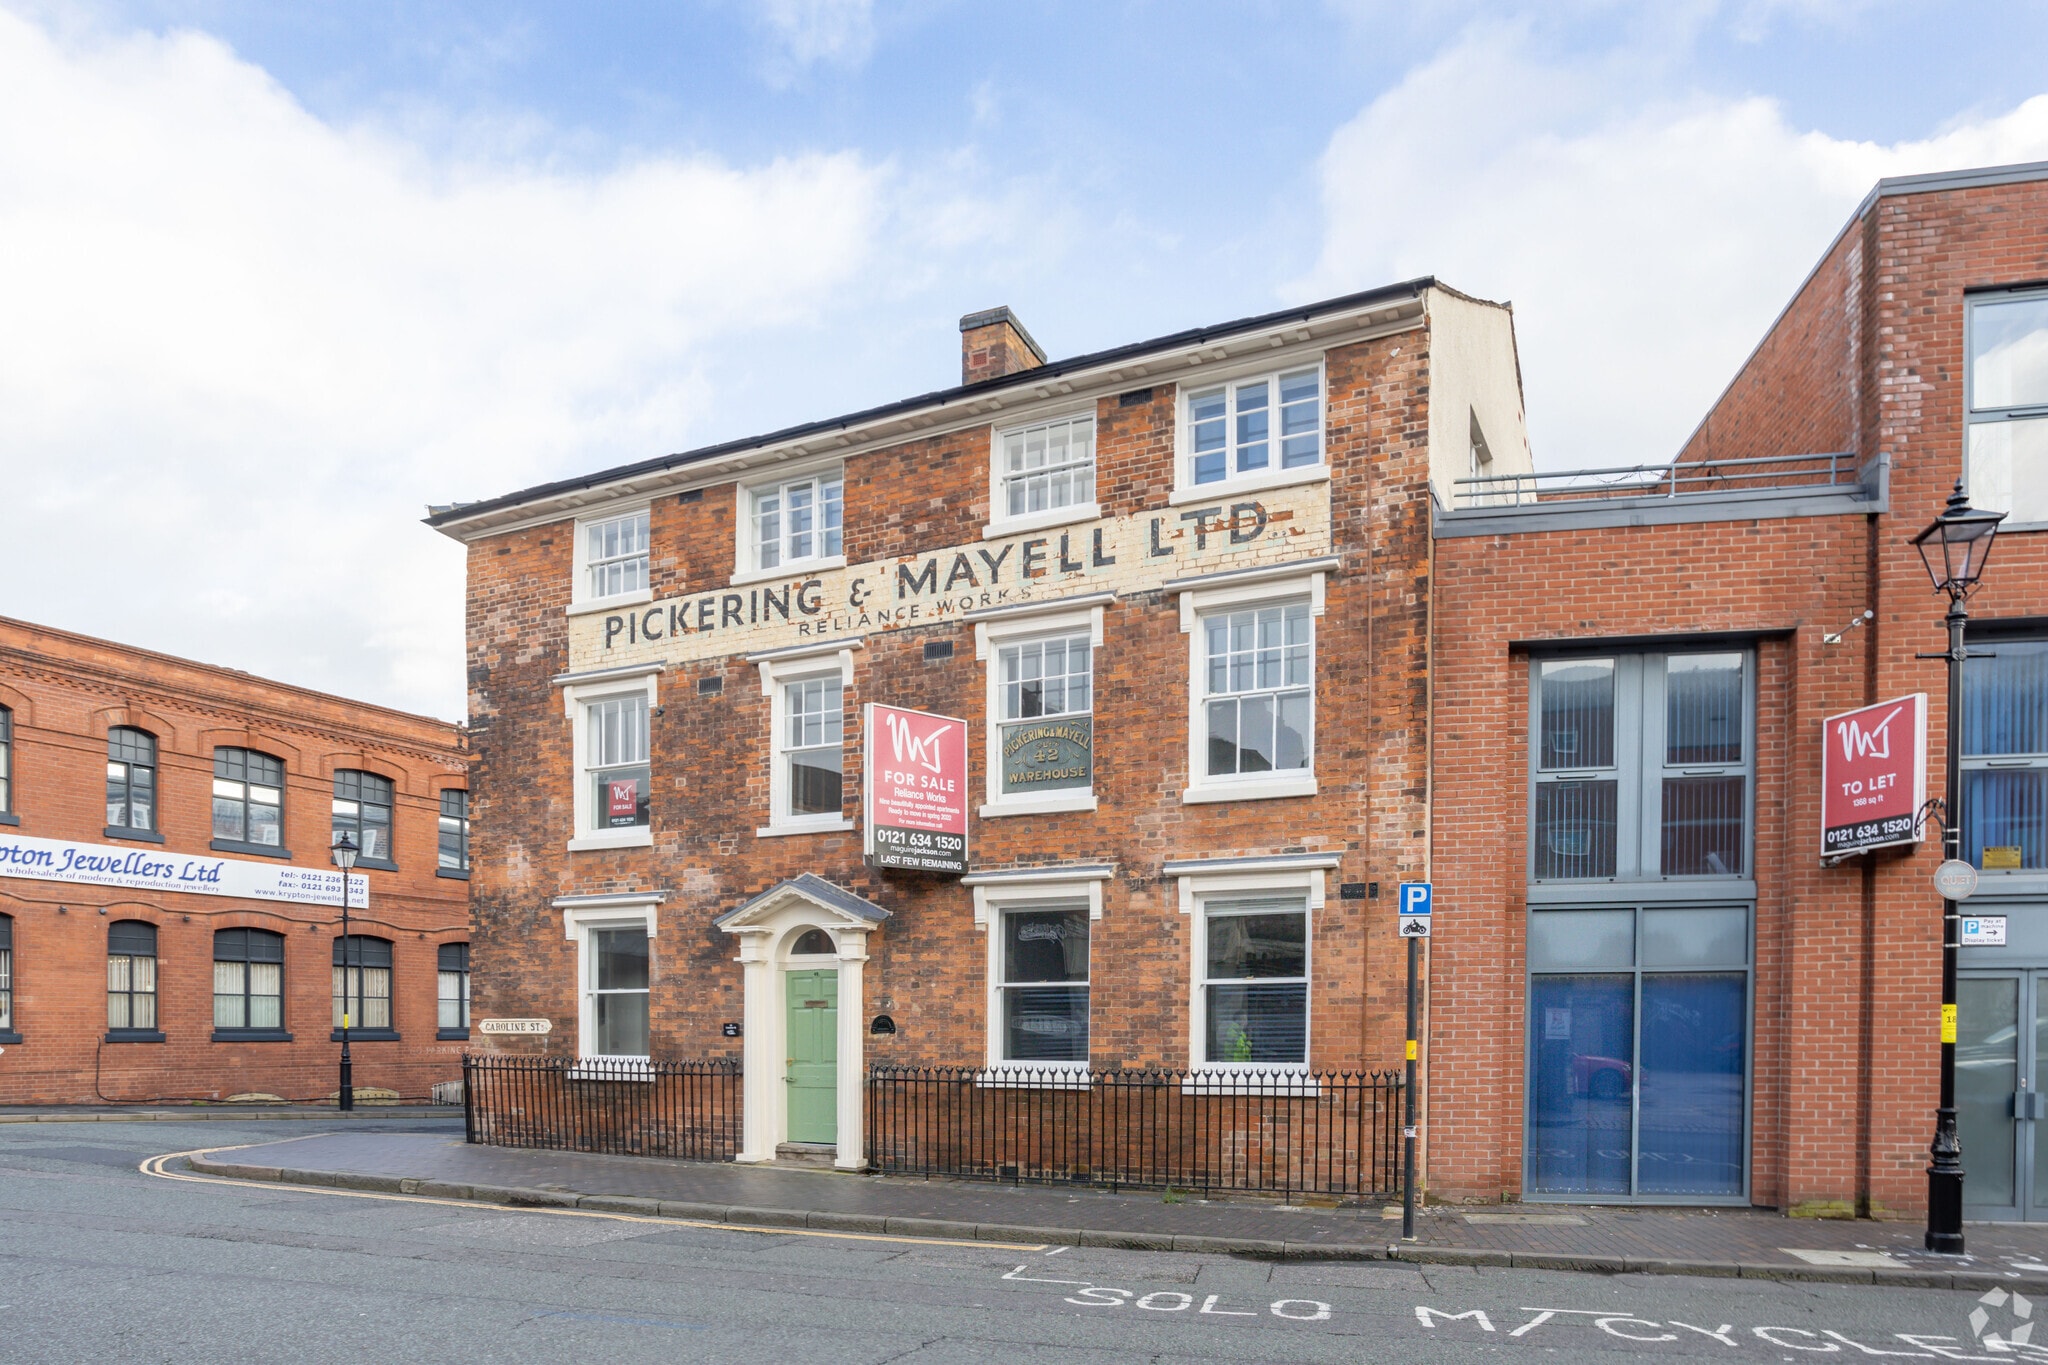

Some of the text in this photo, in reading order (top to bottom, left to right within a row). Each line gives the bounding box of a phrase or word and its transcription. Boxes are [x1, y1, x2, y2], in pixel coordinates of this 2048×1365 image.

[605, 501, 1267, 649] PICKERING & MAYELL LTD
[799, 585, 1032, 636] RELIANCE WORKS
[1003, 726, 1050, 757] PICKERING
[1055, 726, 1090, 750] MAYELL
[1034, 749, 1059, 762] 42
[884, 770, 955, 792] FOR SALE
[1009, 766, 1086, 783] WAREHOUSE
[1842, 773, 1897, 796] TO LET
[894, 787, 947, 803] Reliance Works
[1867, 796, 1877, 806] sq
[1877, 794, 1884, 802] ft
[1827, 818, 1911, 843] 0121 634 1520
[877, 829, 962, 850] 0121 634 1520
[1837, 832, 1900, 848] maguirejackson.com
[890, 845, 952, 857] maguirejackson.com
[56, 848, 175, 879] Jewellers
[178, 861, 225, 883] Ltd
[880, 854, 962, 870] LAST FEW REMAINING
[6, 866, 63, 878] wholesalers
[78, 873, 114, 883] modern
[126, 878, 181, 890] reproduction
[183, 883, 220, 893] jewellery
[301, 873, 322, 882] 0121
[325, 875, 341, 884] 236
[1940, 874, 1972, 886] QUIET
[301, 883, 322, 891] 0121
[325, 885, 341, 893] 693
[1407, 886, 1428, 912] P
[1967, 922, 1978, 933] P
[485, 1022, 526, 1032] CAROLINE
[530, 1022, 540, 1031] ST
[1063, 1286, 1332, 1321] SOLO
